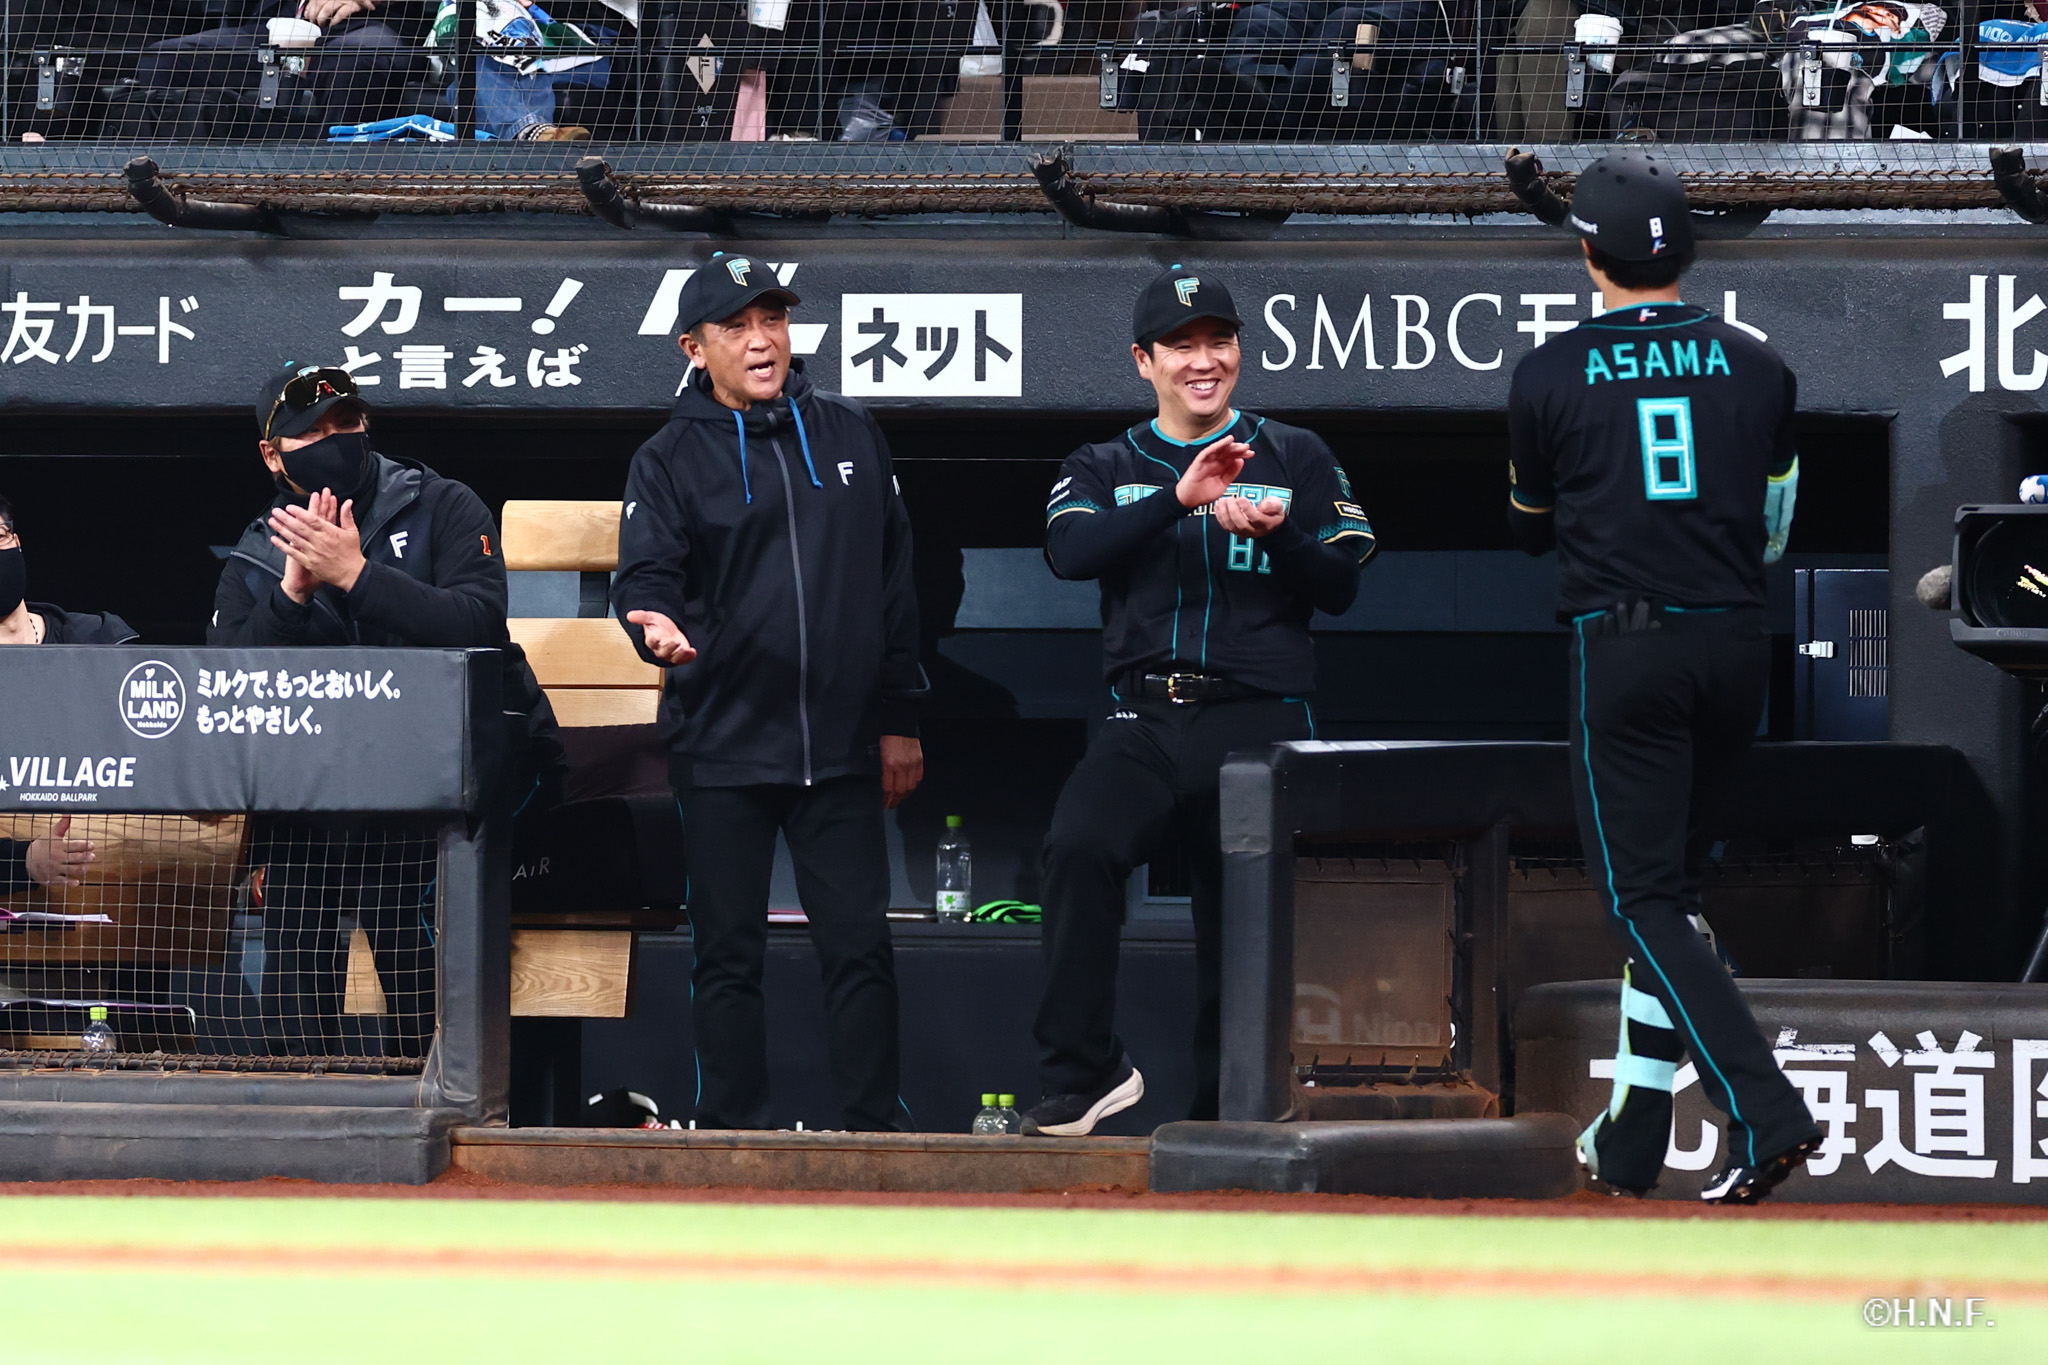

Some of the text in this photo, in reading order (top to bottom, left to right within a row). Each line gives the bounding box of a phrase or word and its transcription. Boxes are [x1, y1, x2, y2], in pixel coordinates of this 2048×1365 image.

[1649, 216, 1664, 239] 8
[0, 291, 199, 364] 友カード
[850, 307, 1013, 382] ネット
[339, 344, 589, 390] と言えば
[1585, 339, 1731, 385] ASAMA
[1637, 397, 1698, 500] 8
[389, 530, 409, 558] F
[197, 668, 401, 700] ミルクで、もっとおいしく。
[127, 700, 180, 719] LAND
[136, 721, 168, 729] Hokkaido
[196, 704, 322, 736] もっとやさしく。
[9, 756, 137, 788] VILLAGE
[19, 792, 98, 802] HOKKAIDO BALLPARK
